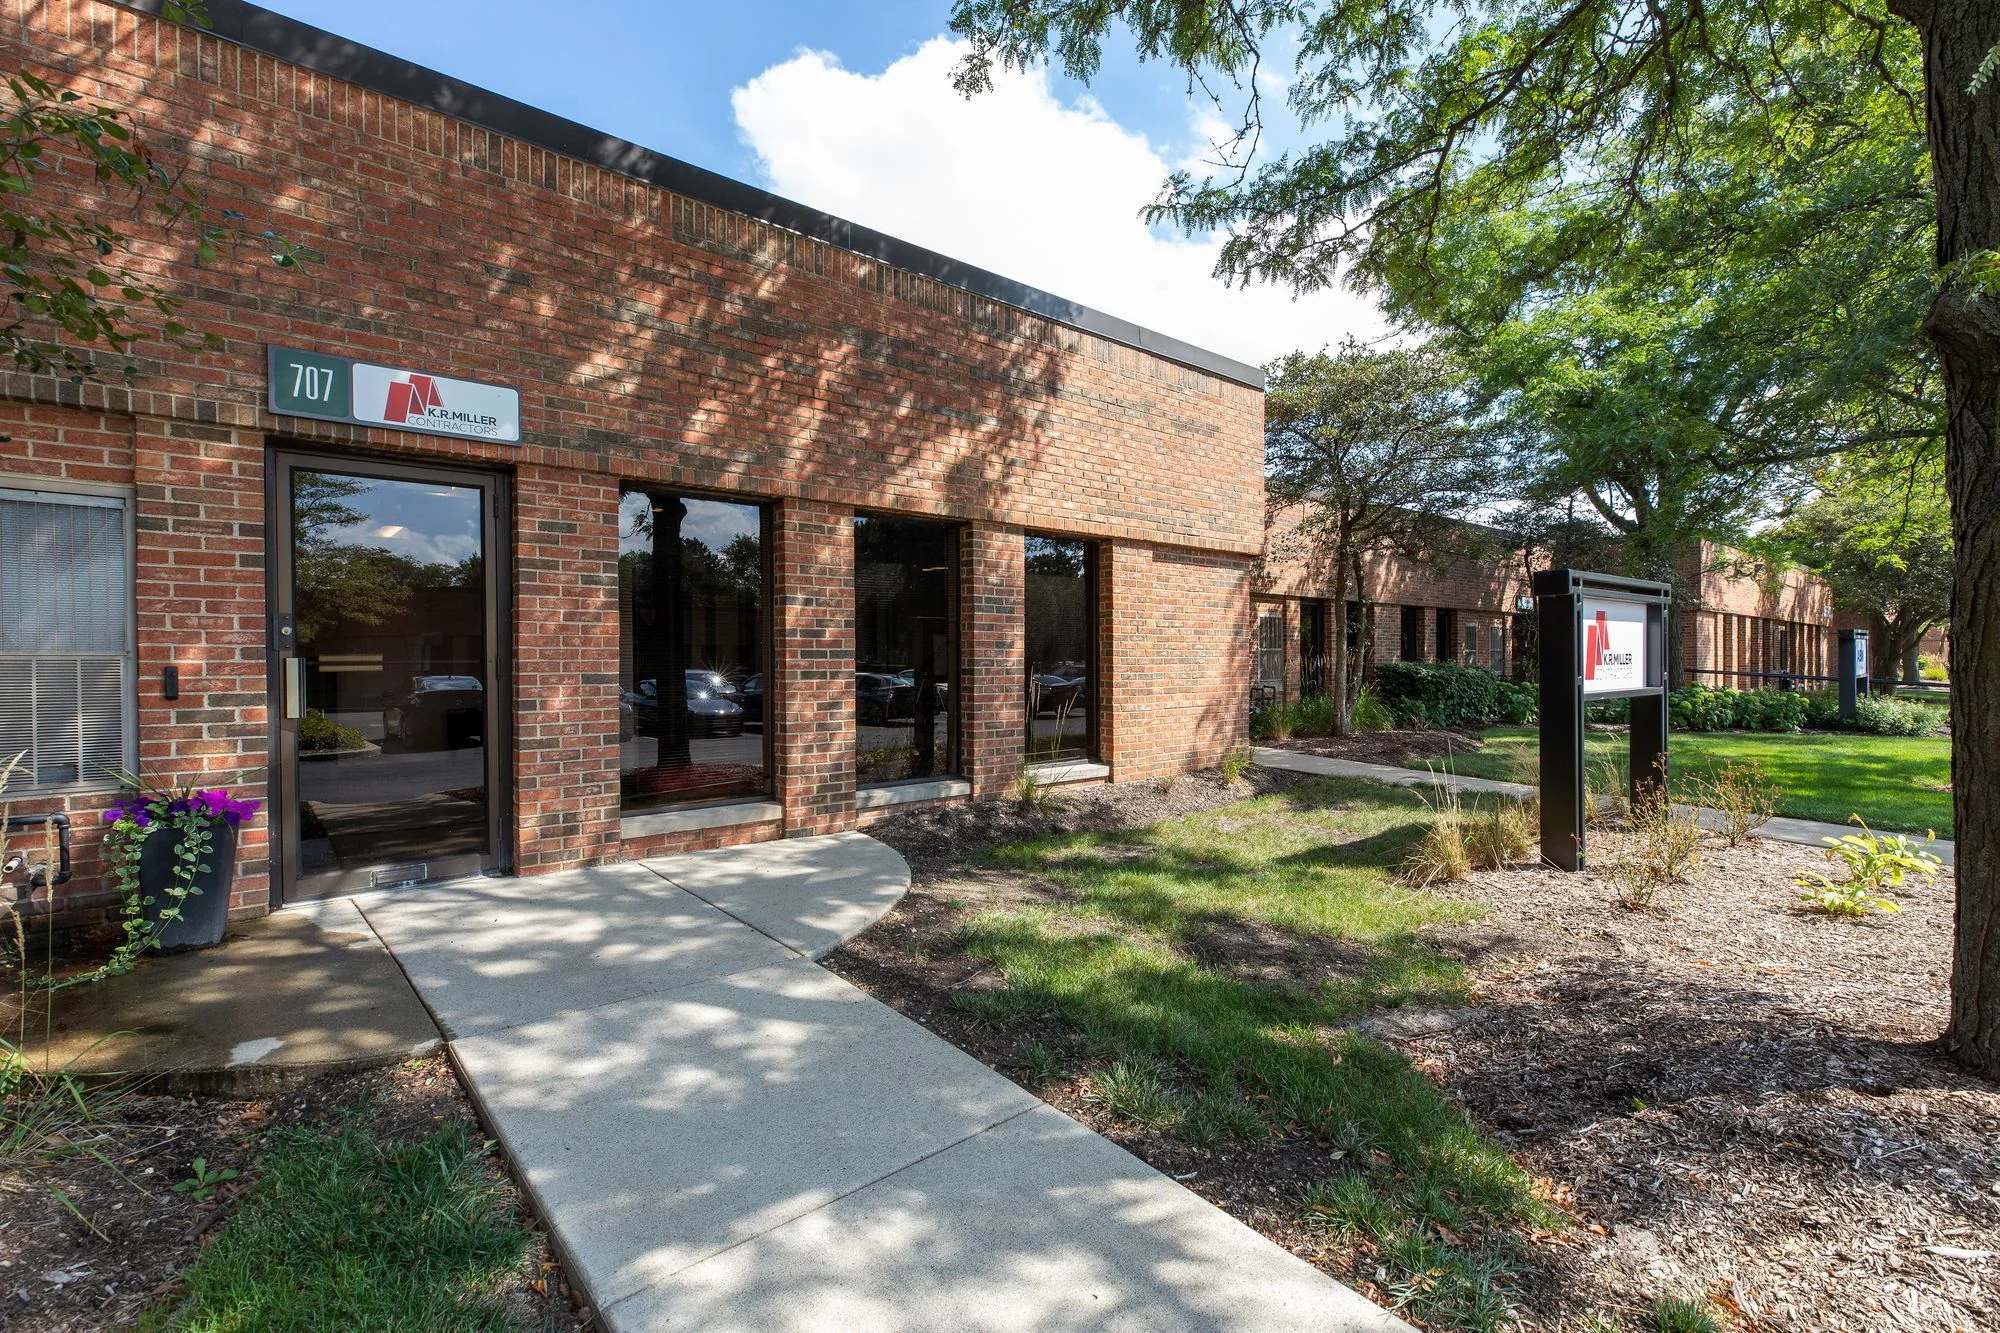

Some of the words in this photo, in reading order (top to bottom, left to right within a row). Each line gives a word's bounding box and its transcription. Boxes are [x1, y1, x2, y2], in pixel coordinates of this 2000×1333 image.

[290, 363, 334, 402] 707
[407, 416, 498, 437] CONTRACTORS
[428, 408, 497, 427] K.R.MILLER
